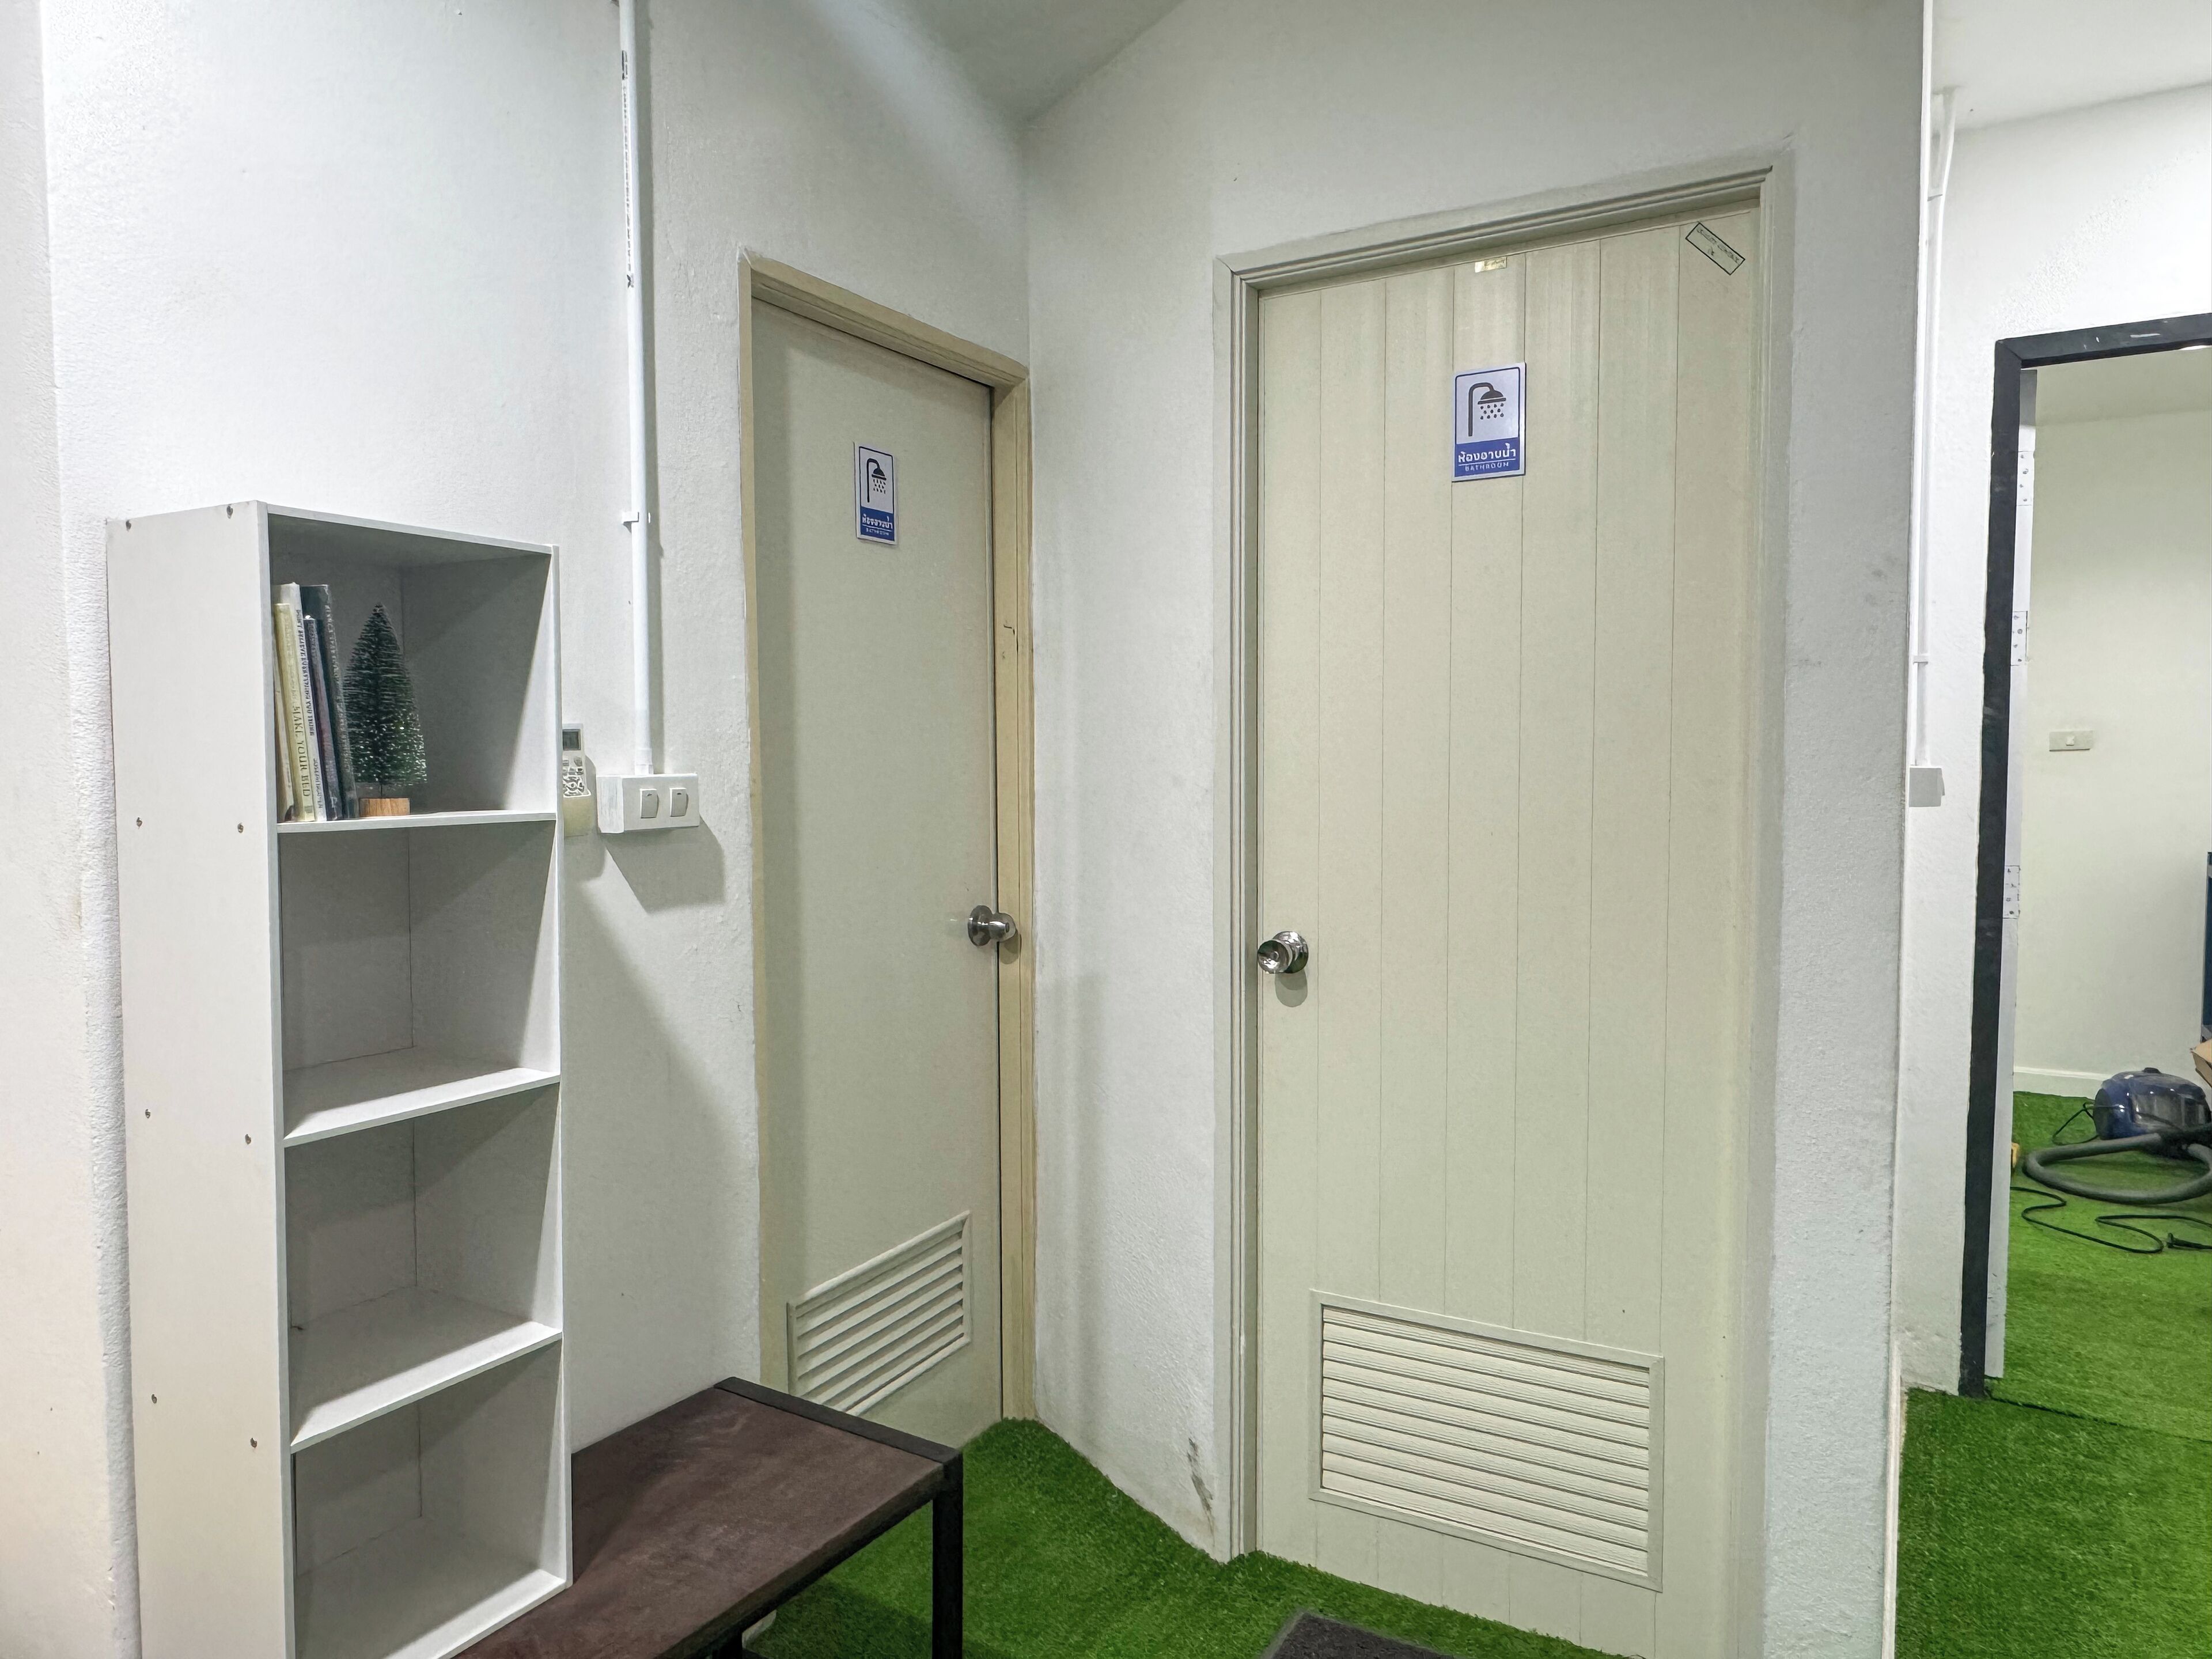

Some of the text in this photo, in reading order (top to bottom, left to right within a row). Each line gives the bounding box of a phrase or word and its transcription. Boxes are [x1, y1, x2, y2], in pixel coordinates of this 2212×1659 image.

[1458, 442, 1516, 463] ห้องอาบน้ำ
[1465, 462, 1509, 472] BATHROOM
[293, 706, 310, 796] MAKE YOUR BED
